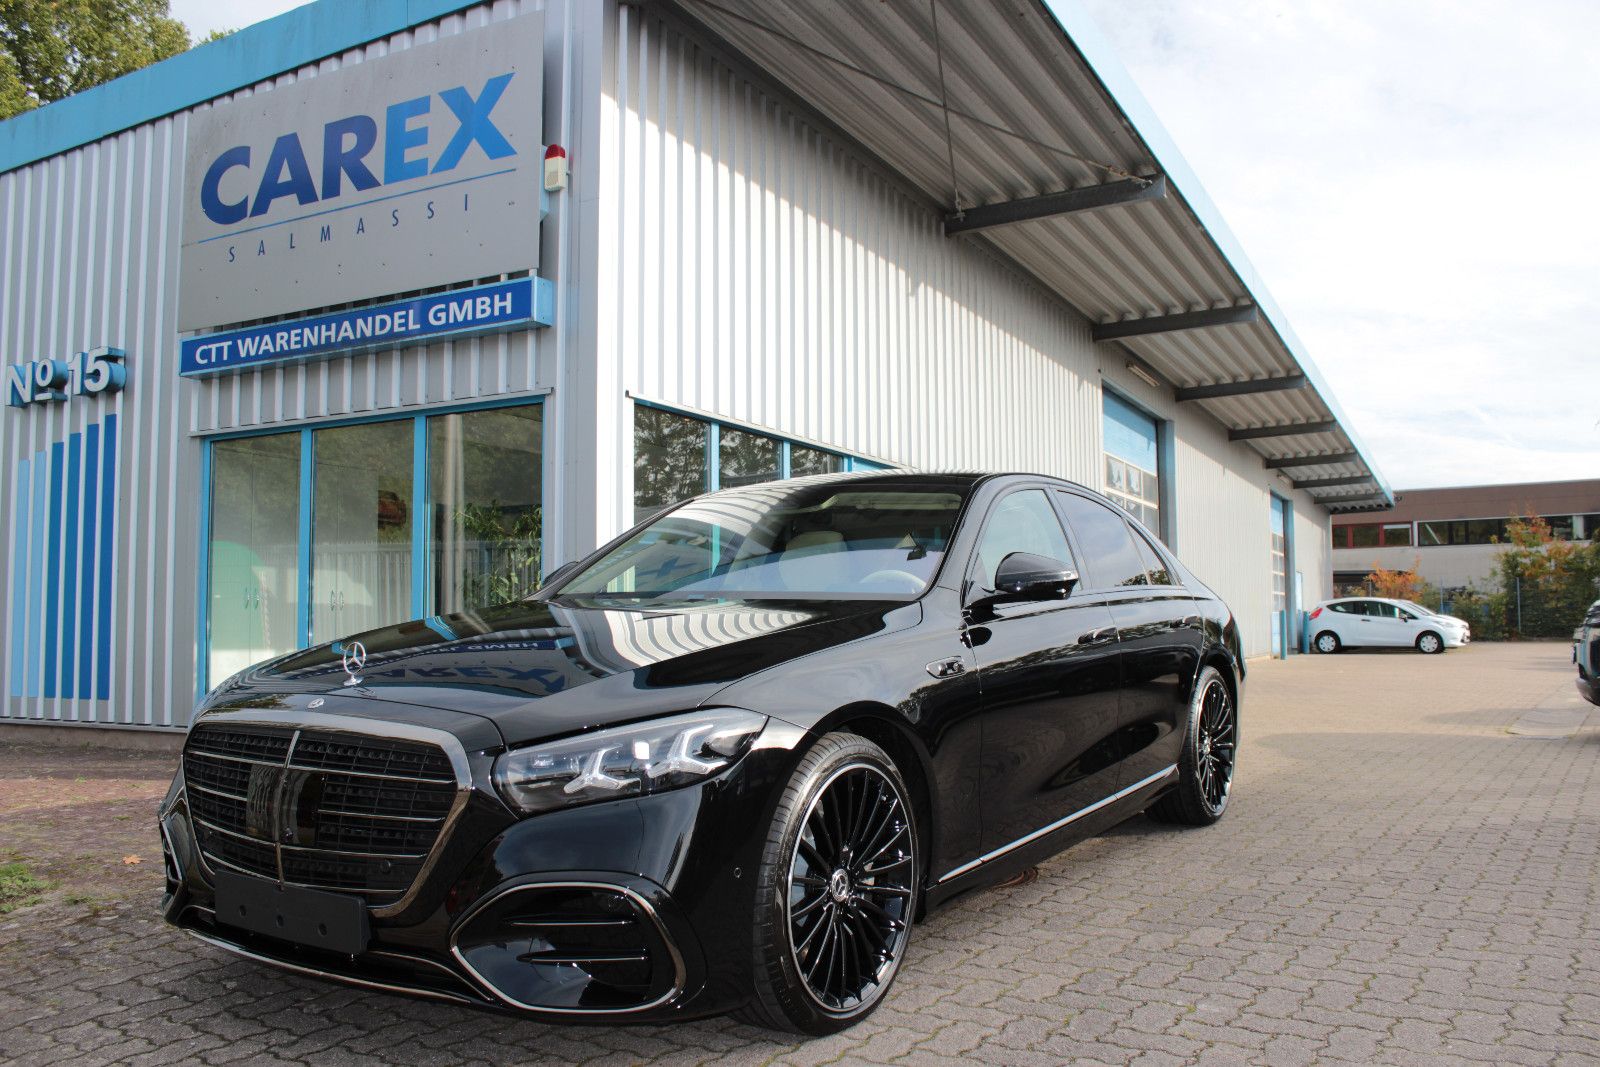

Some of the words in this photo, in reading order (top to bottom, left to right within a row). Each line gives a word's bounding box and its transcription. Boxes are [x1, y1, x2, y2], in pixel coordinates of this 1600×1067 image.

[200, 72, 517, 226] CAREX
[229, 194, 469, 262] SALMASSI
[195, 340, 232, 364] CTT
[237, 310, 420, 358] WARENHANDEL
[428, 292, 512, 326] GMBH
[68, 346, 110, 395] 15
